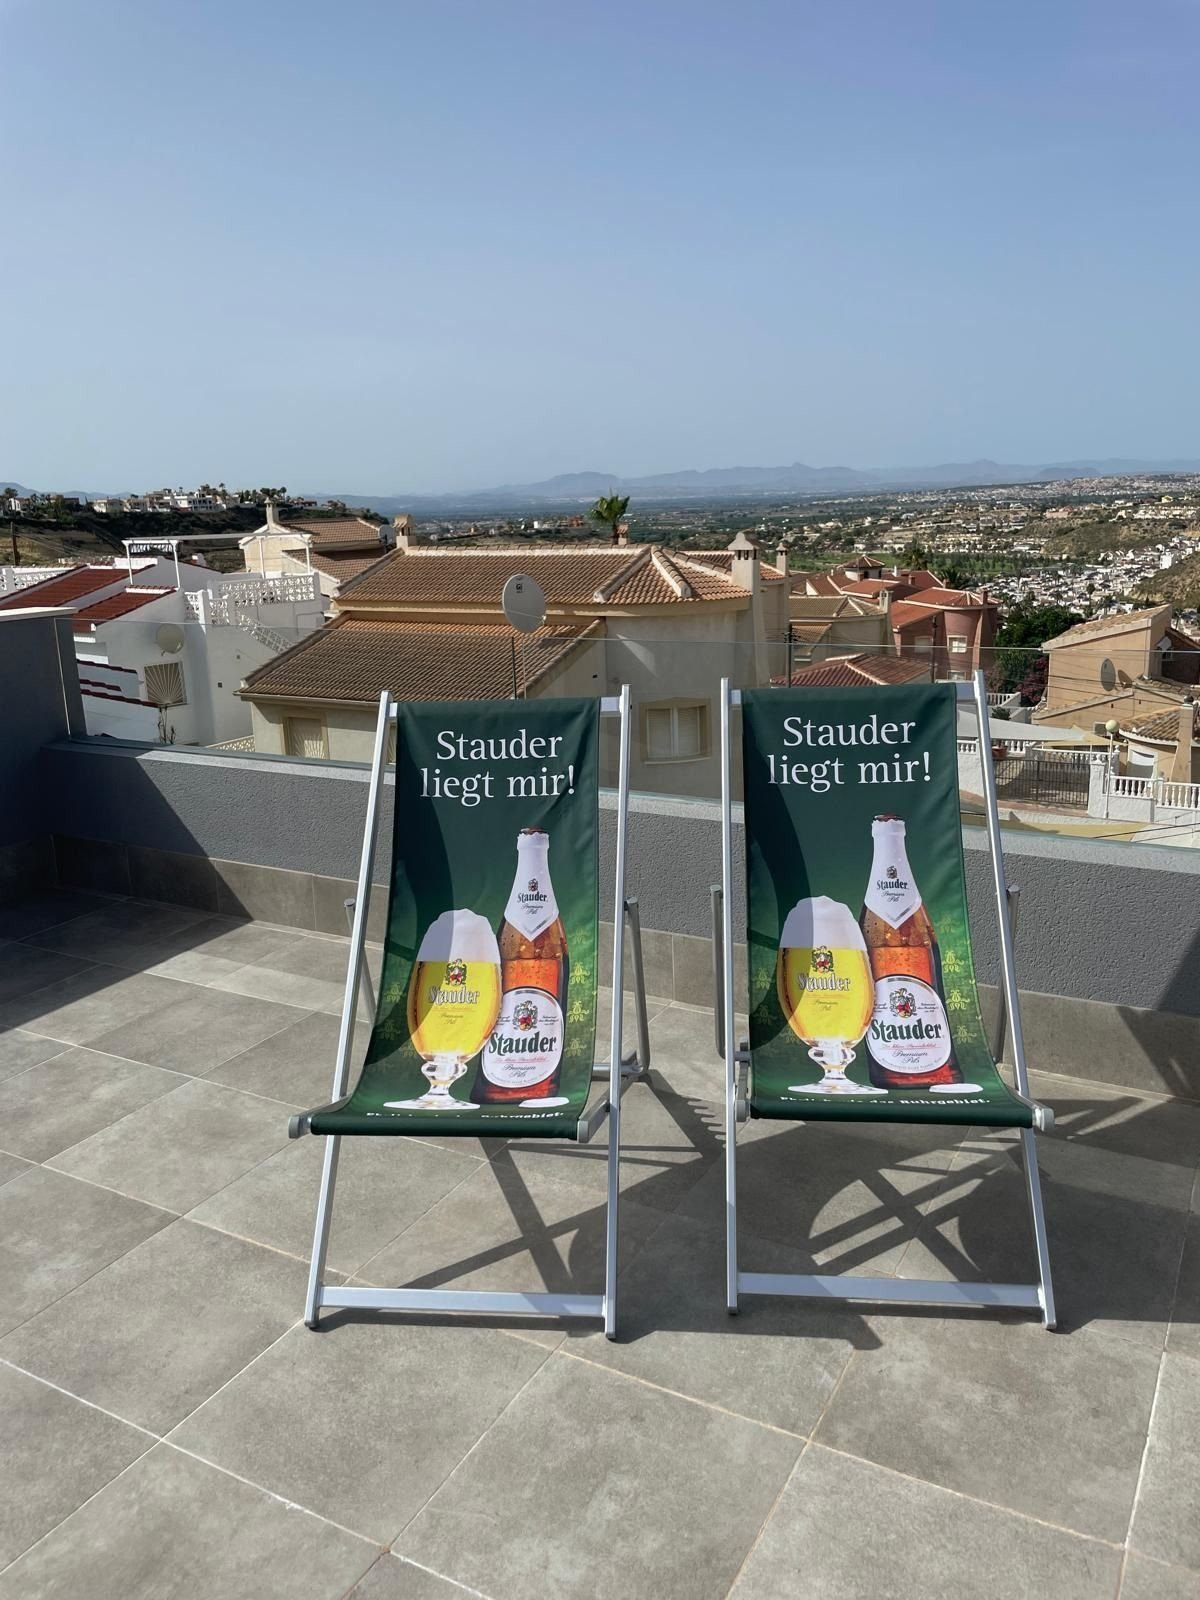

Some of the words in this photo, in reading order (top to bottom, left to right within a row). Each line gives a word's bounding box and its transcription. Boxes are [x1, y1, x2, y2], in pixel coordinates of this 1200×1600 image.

[783, 714, 916, 747] Stauder
[436, 728, 563, 760] Stauder
[767, 754, 845, 793] liegt
[857, 751, 931, 784] mir!
[419, 767, 495, 807] liegt
[506, 764, 576, 798] mir!
[876, 878, 908, 890] Stauder
[517, 891, 547, 903] Stauder
[798, 972, 850, 992] Stauder
[428, 985, 480, 1006] Stauder
[871, 1018, 942, 1043] Stauder
[488, 1031, 557, 1057] Stauder
